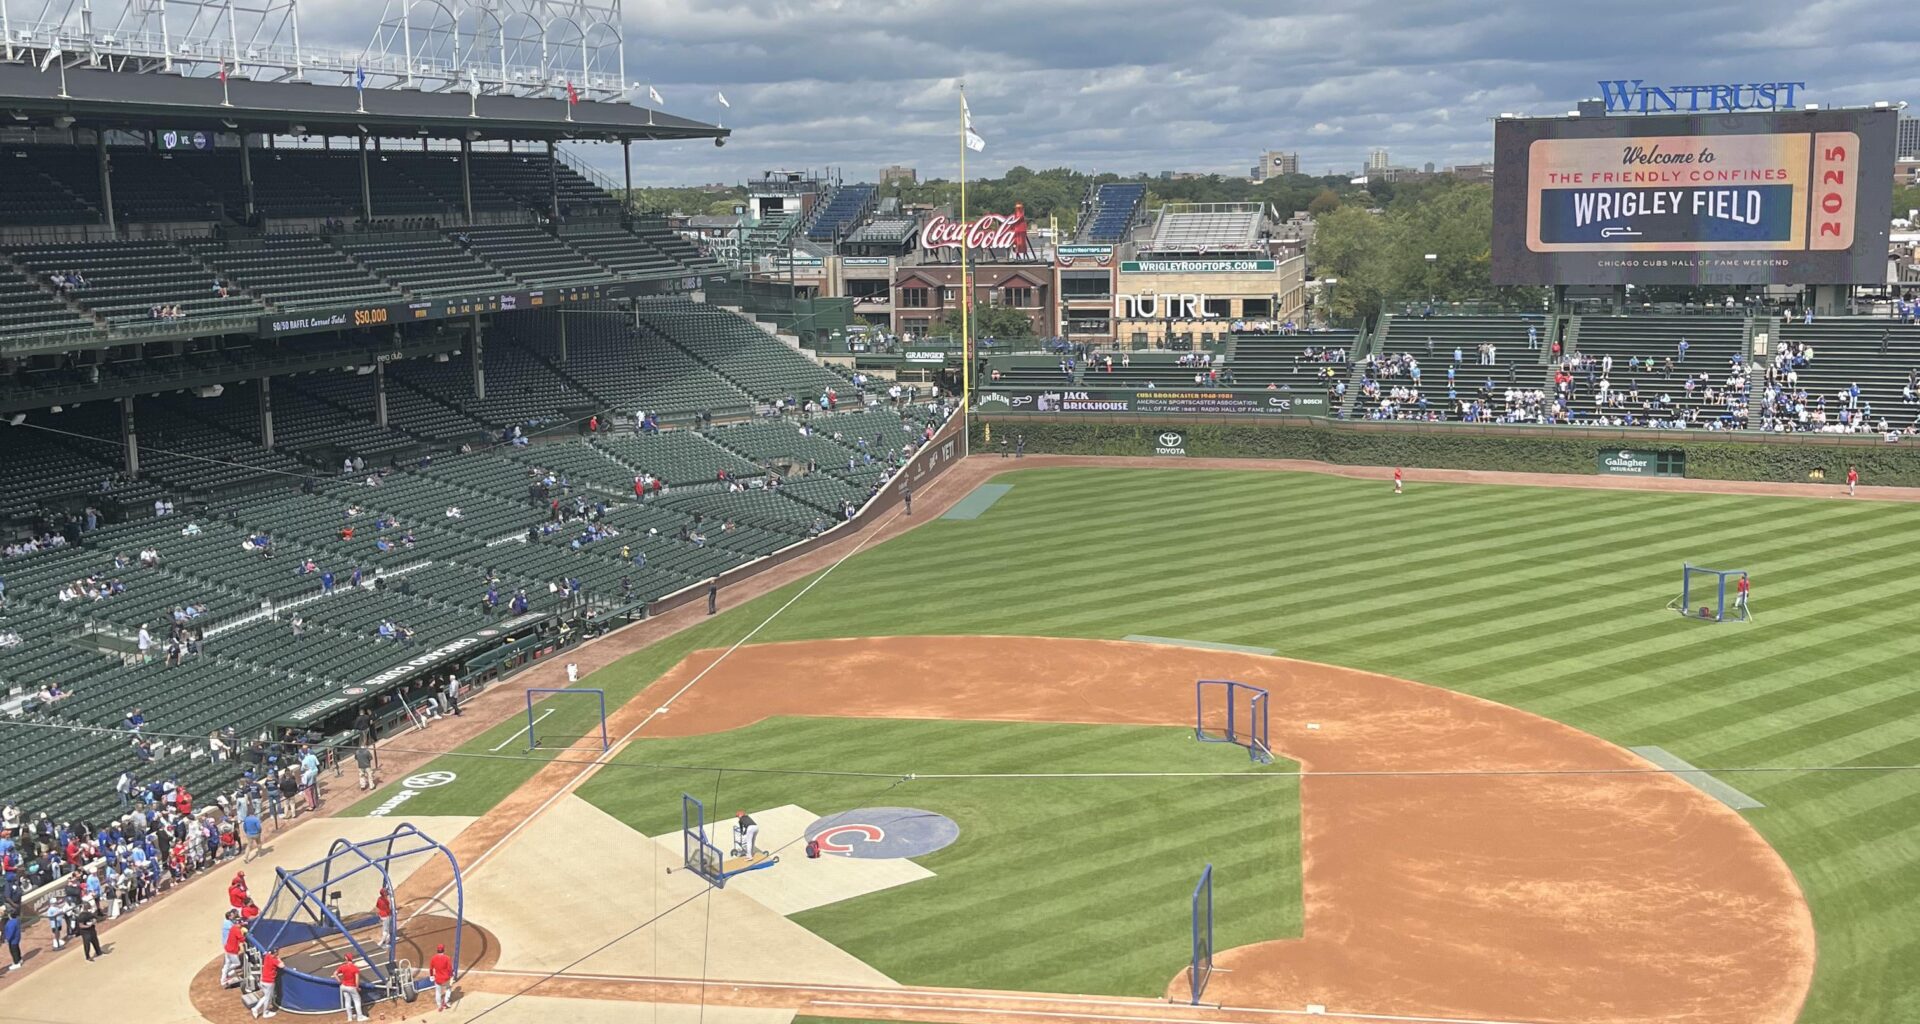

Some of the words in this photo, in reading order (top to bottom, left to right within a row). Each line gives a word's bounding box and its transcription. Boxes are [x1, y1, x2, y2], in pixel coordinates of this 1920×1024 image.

[1598, 79, 1805, 113] WINTRUST
[1622, 144, 1694, 165] Welcome
[1698, 147, 1716, 163] to
[1549, 173, 1583, 184] THE
[1591, 170, 1681, 183] FRIENDLY
[1690, 168, 1788, 181] CONFINES
[1820, 146, 1846, 237] 2025
[1574, 191, 1683, 227] WRIGLEY
[1692, 190, 1761, 225] FIELD
[921, 215, 1021, 249] Coca-Cola
[1138, 261, 1258, 271] WRIGLEYROOFTOPS.COM
[272, 320, 290, 331] 50/50
[290, 318, 309, 329] RAFFLE
[354, 308, 387, 326] $50,000
[905, 351, 945, 359] GRAINGER
[979, 393, 992, 406] JIM
[992, 392, 1010, 406] BEAM
[1063, 391, 1090, 400] JACK
[1063, 402, 1129, 411] BRICKHOUSE
[941, 440, 955, 462] YETI
[1155, 447, 1186, 455] TOYOTA
[1605, 458, 1648, 467] Gallagher
[408, 638, 478, 665] CHICAGO
[364, 665, 415, 685] CUBS
